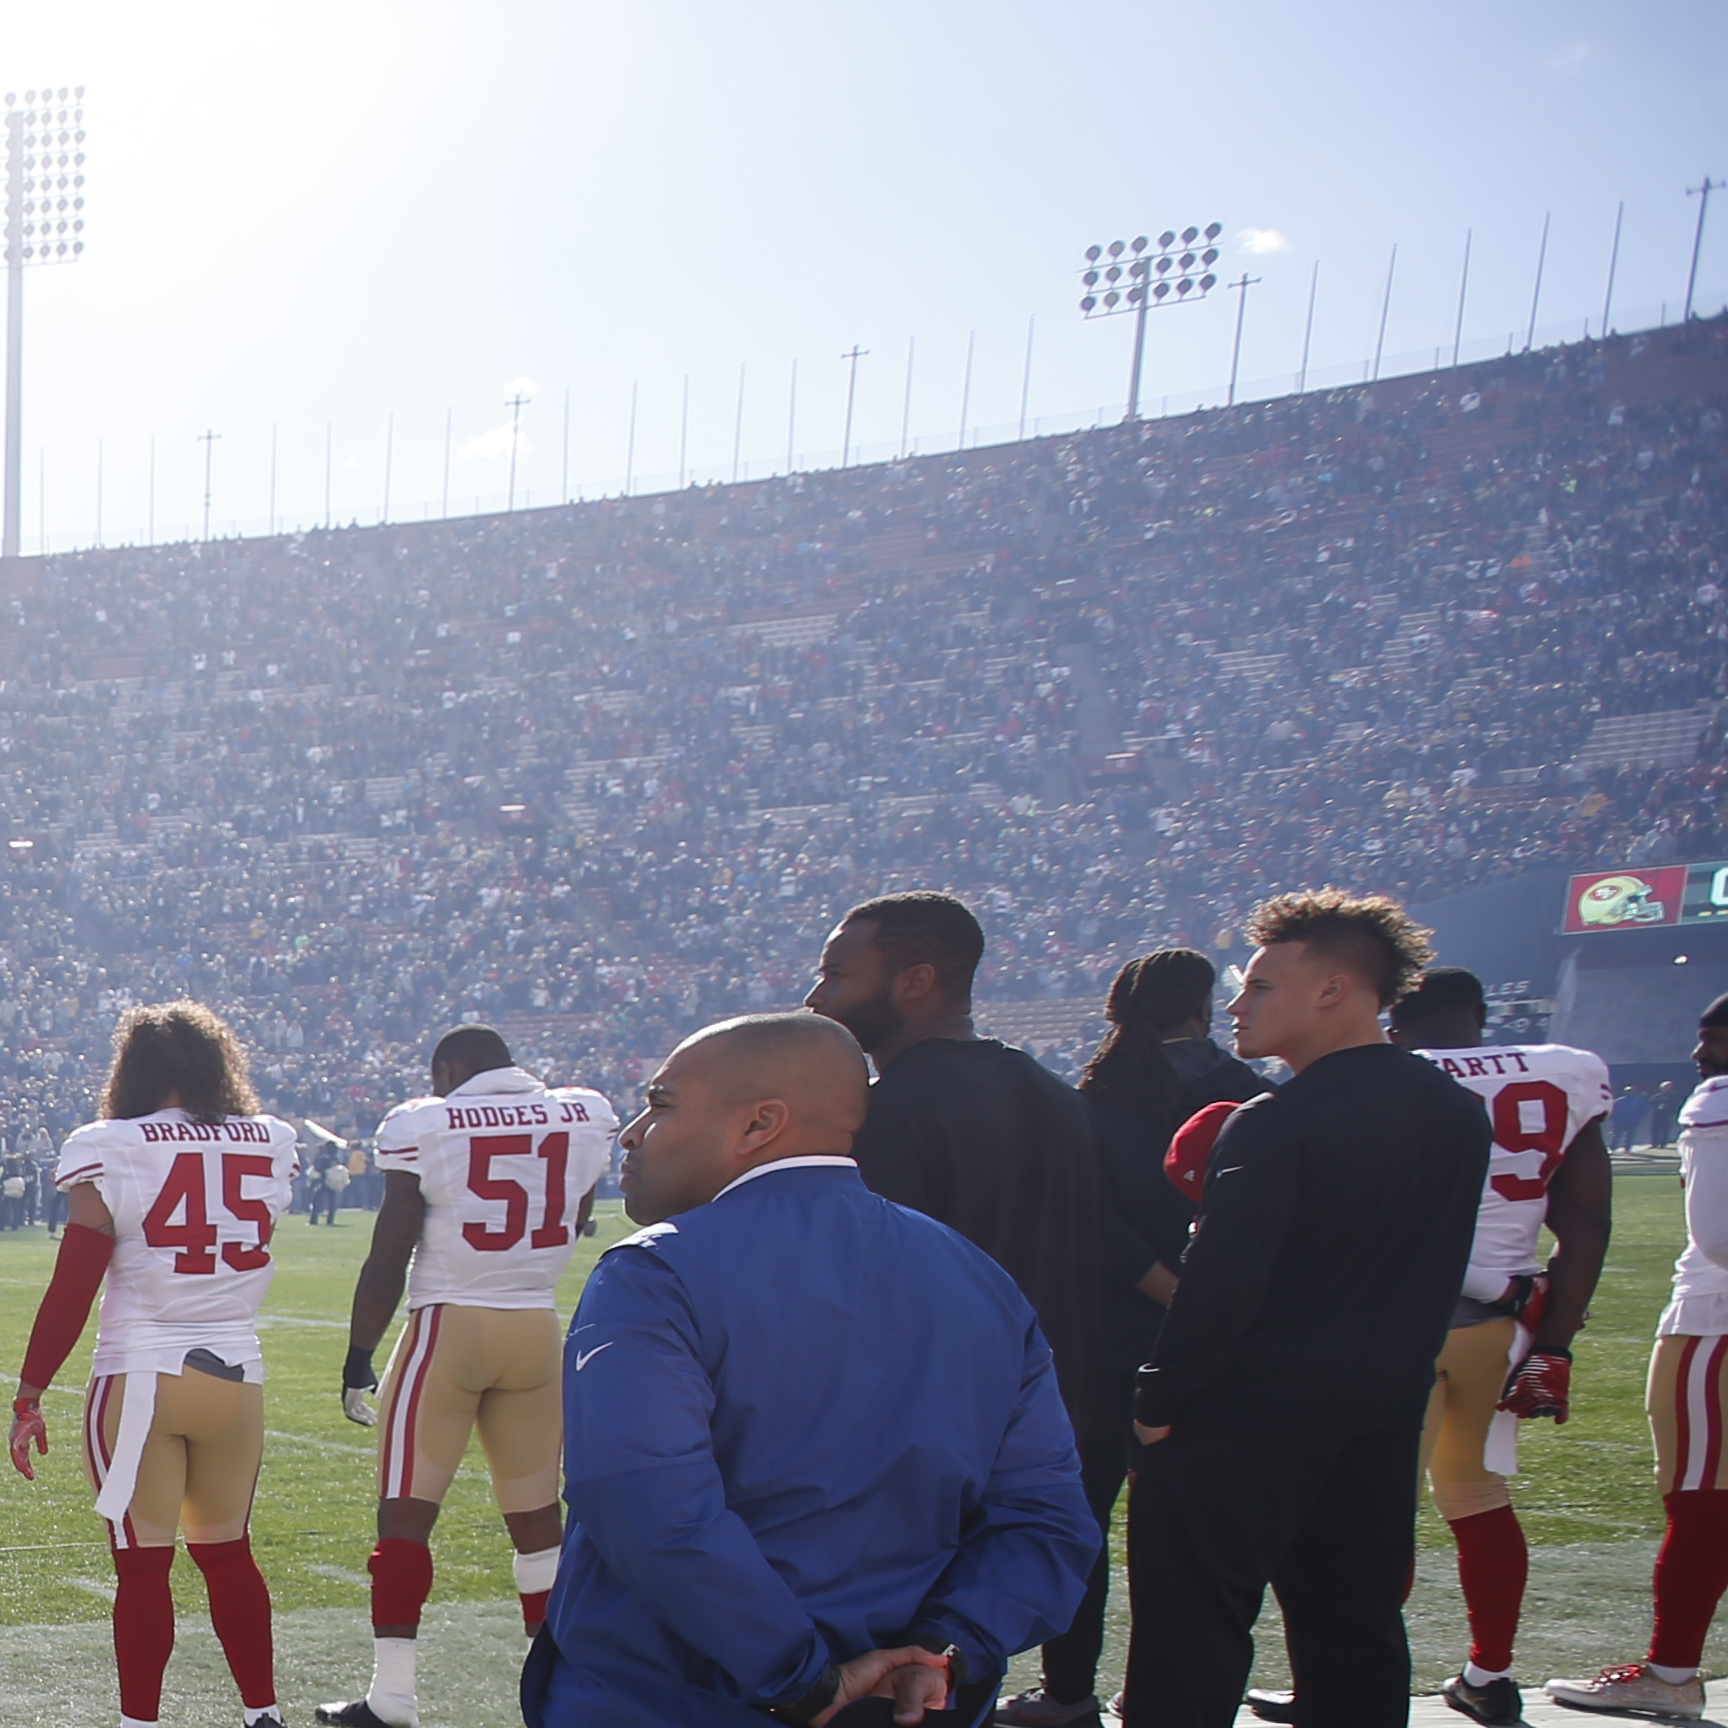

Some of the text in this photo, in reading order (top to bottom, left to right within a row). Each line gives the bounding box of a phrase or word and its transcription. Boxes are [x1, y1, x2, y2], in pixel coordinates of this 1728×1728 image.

[139, 1121, 271, 1143] BRADFORD
[446, 1102, 590, 1129] HODGES JR
[1471, 1080, 1569, 1202] 9
[142, 1152, 274, 1274] 45
[462, 1131, 570, 1251] 51
